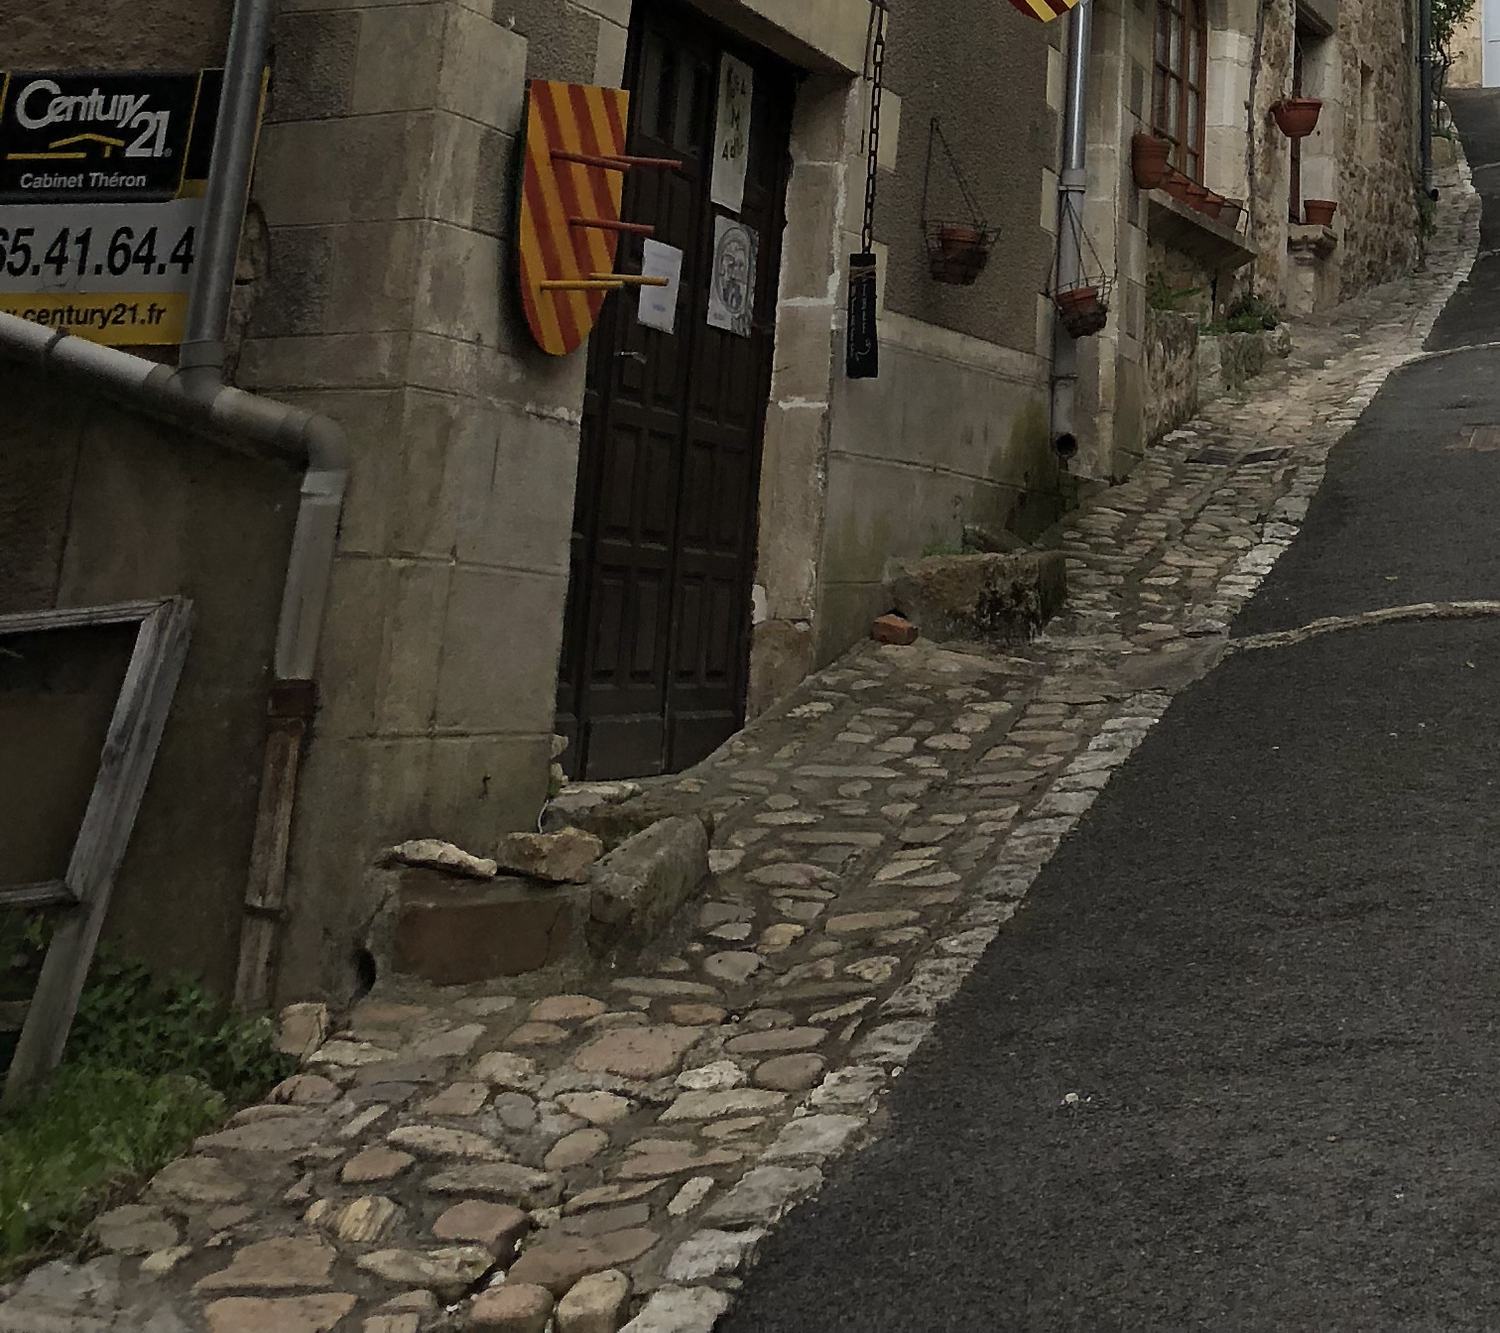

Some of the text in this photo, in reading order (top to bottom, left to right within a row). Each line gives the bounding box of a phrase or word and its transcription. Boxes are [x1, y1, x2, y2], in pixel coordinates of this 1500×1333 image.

[15, 79, 171, 158] Century 21
[19, 170, 147, 189] Cabinet Théron
[5, 303, 168, 330] century21.fr
